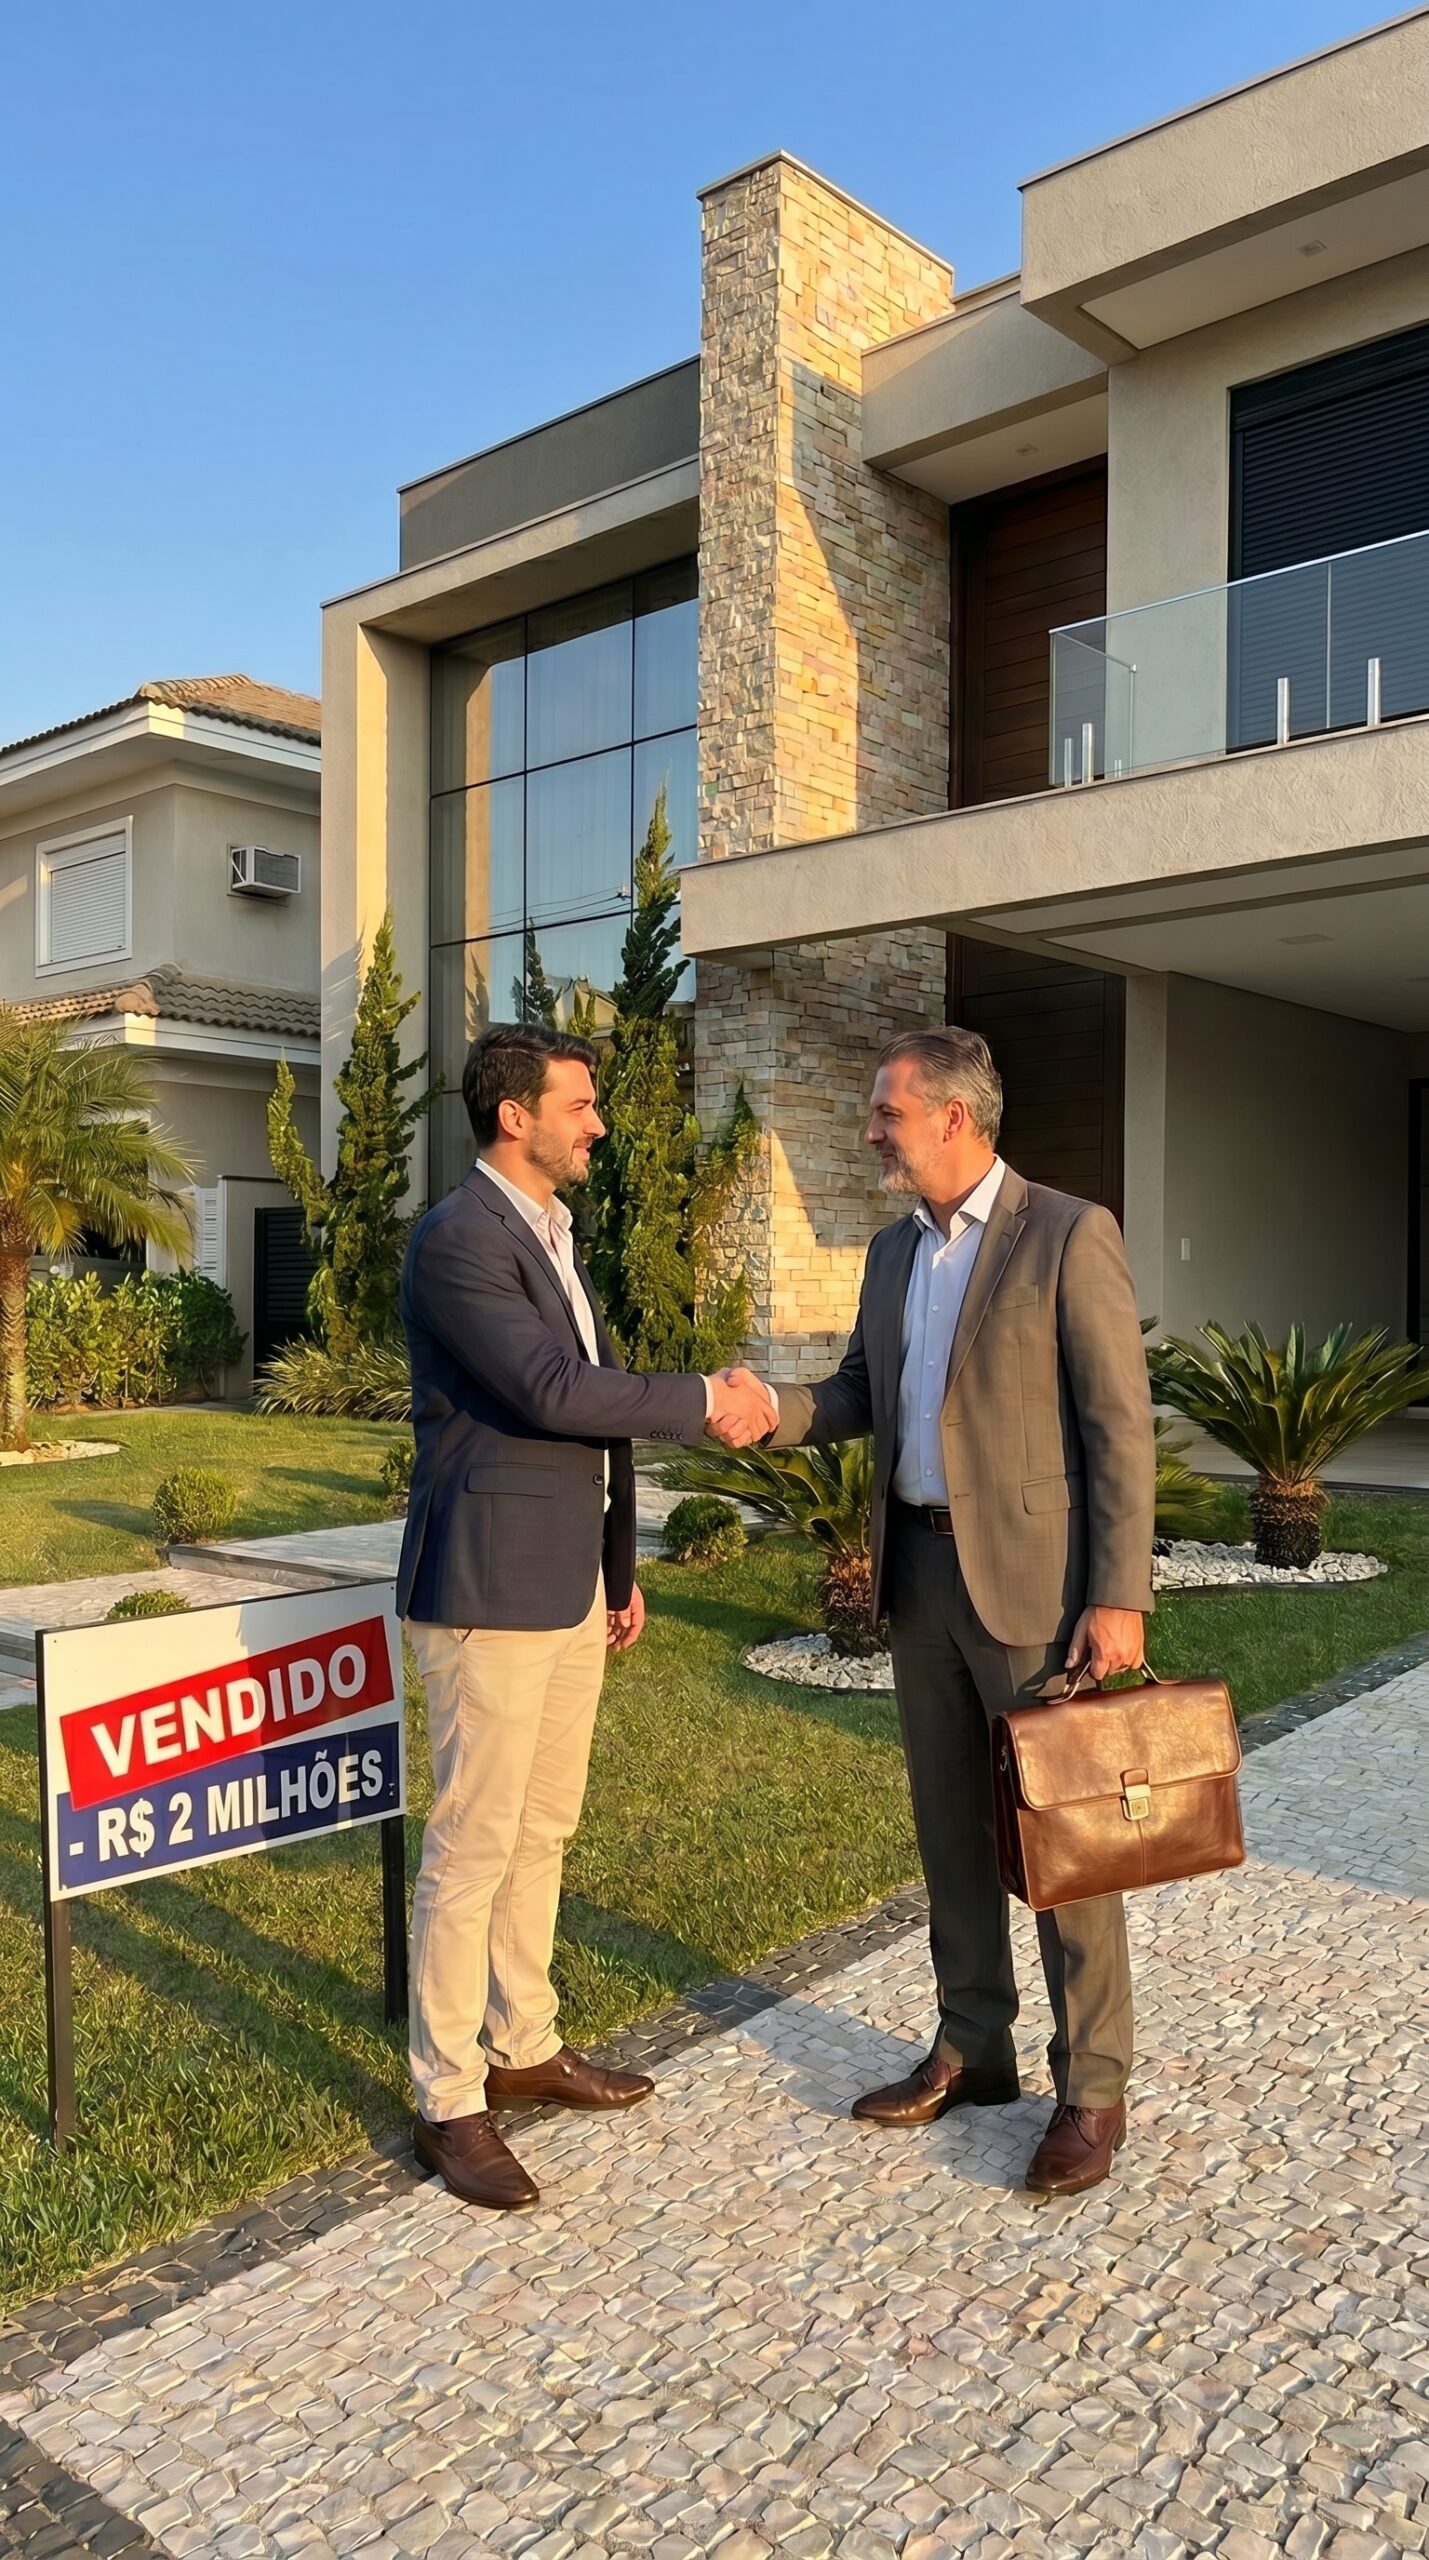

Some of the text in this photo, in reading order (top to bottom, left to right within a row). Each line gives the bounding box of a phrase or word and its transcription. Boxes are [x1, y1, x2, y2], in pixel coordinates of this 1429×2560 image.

[90, 1643, 366, 1778] VENDIDO
[97, 1797, 155, 1862] R$
[168, 1792, 194, 1846] 2
[207, 1749, 383, 1836] MILHÕES
